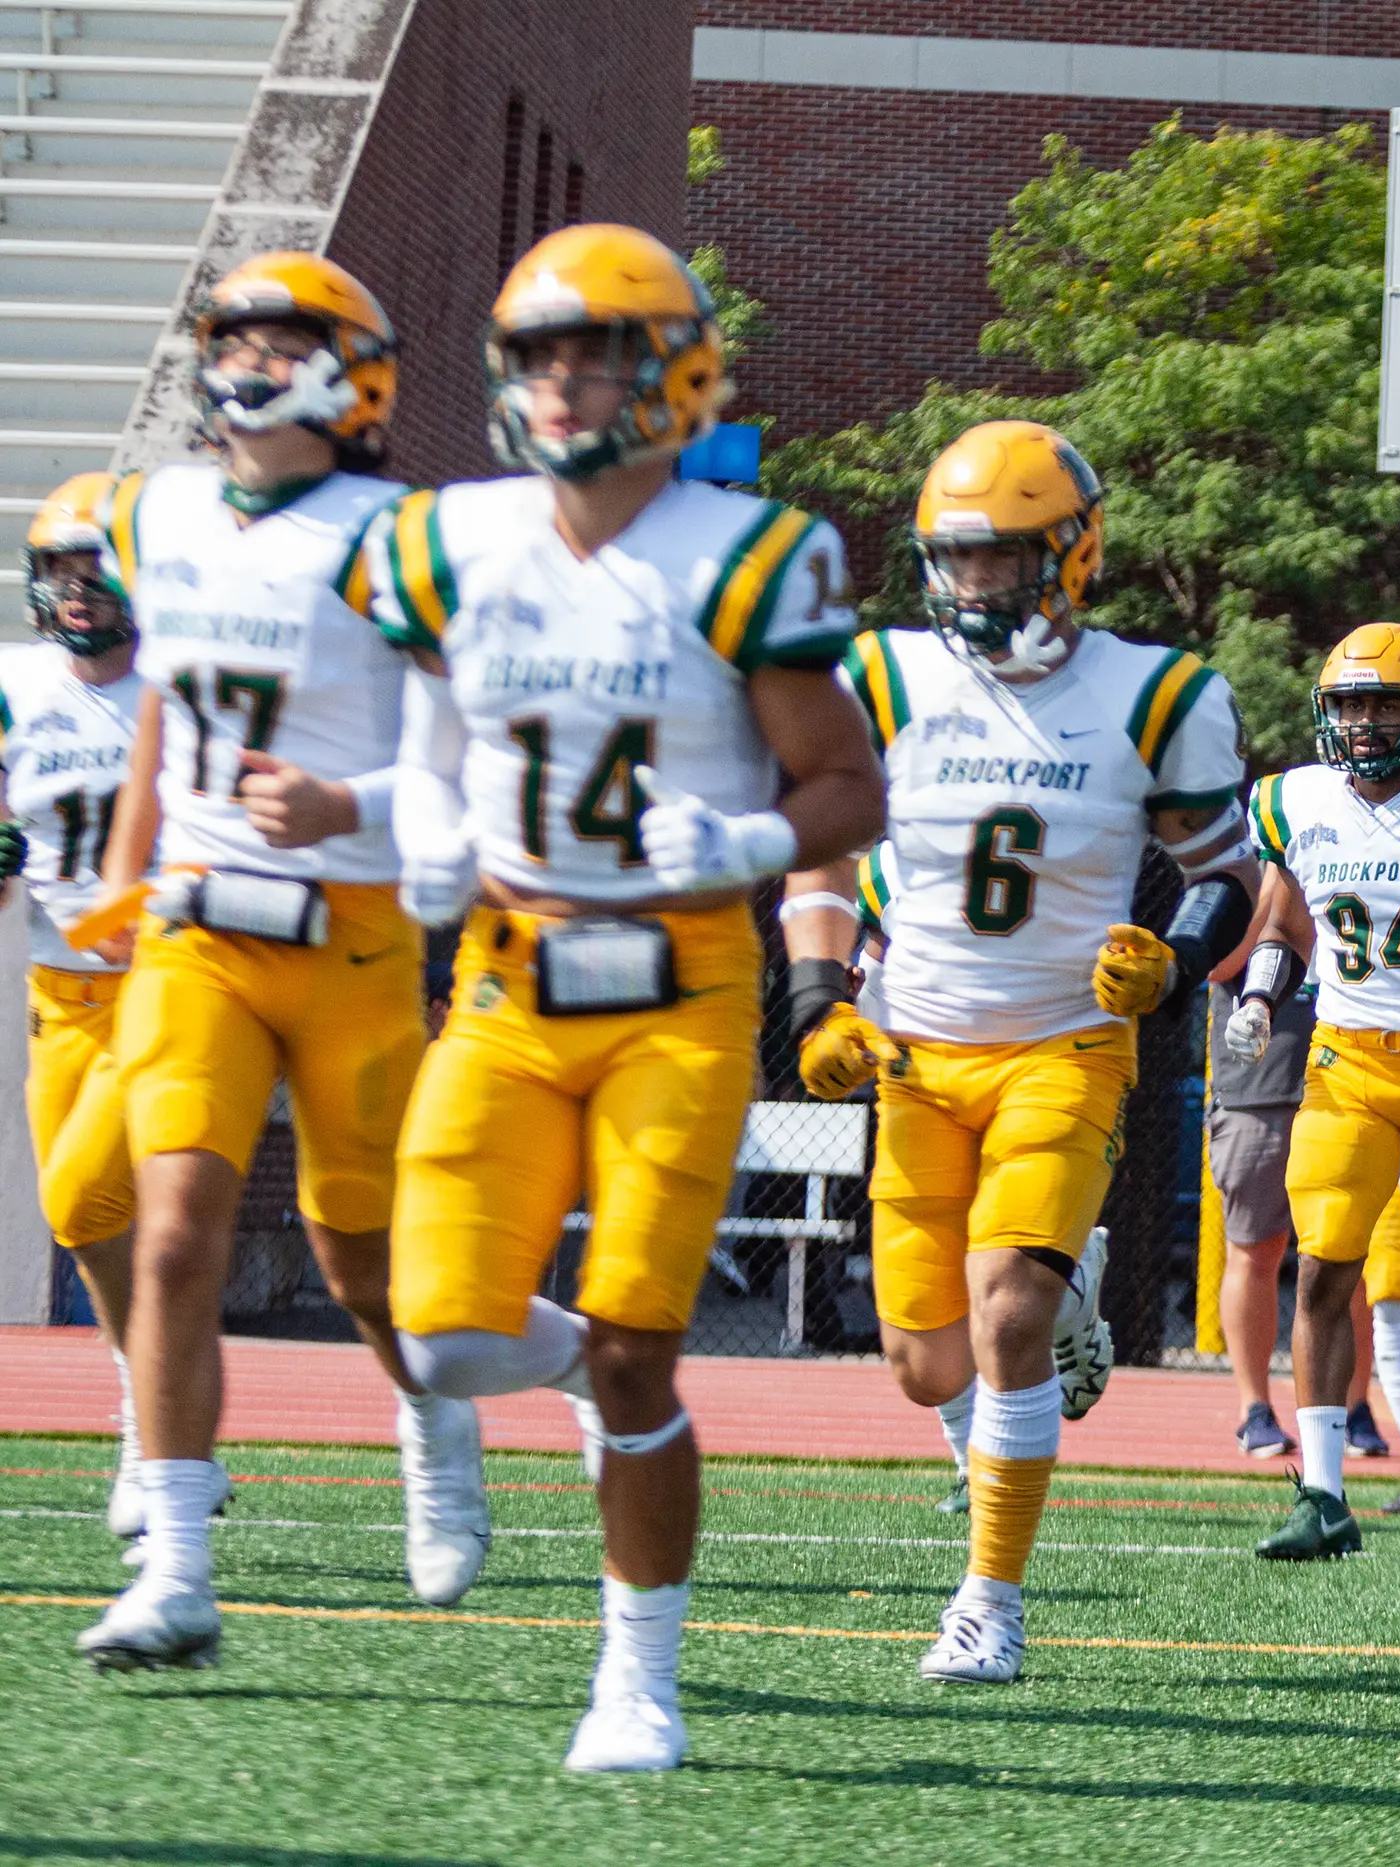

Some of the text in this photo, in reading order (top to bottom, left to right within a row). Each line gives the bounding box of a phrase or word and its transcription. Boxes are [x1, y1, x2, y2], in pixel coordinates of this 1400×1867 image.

[168, 664, 290, 803] 17
[506, 712, 657, 868] 14
[936, 757, 1091, 791] BROCKPORT
[960, 801, 1047, 937] 6
